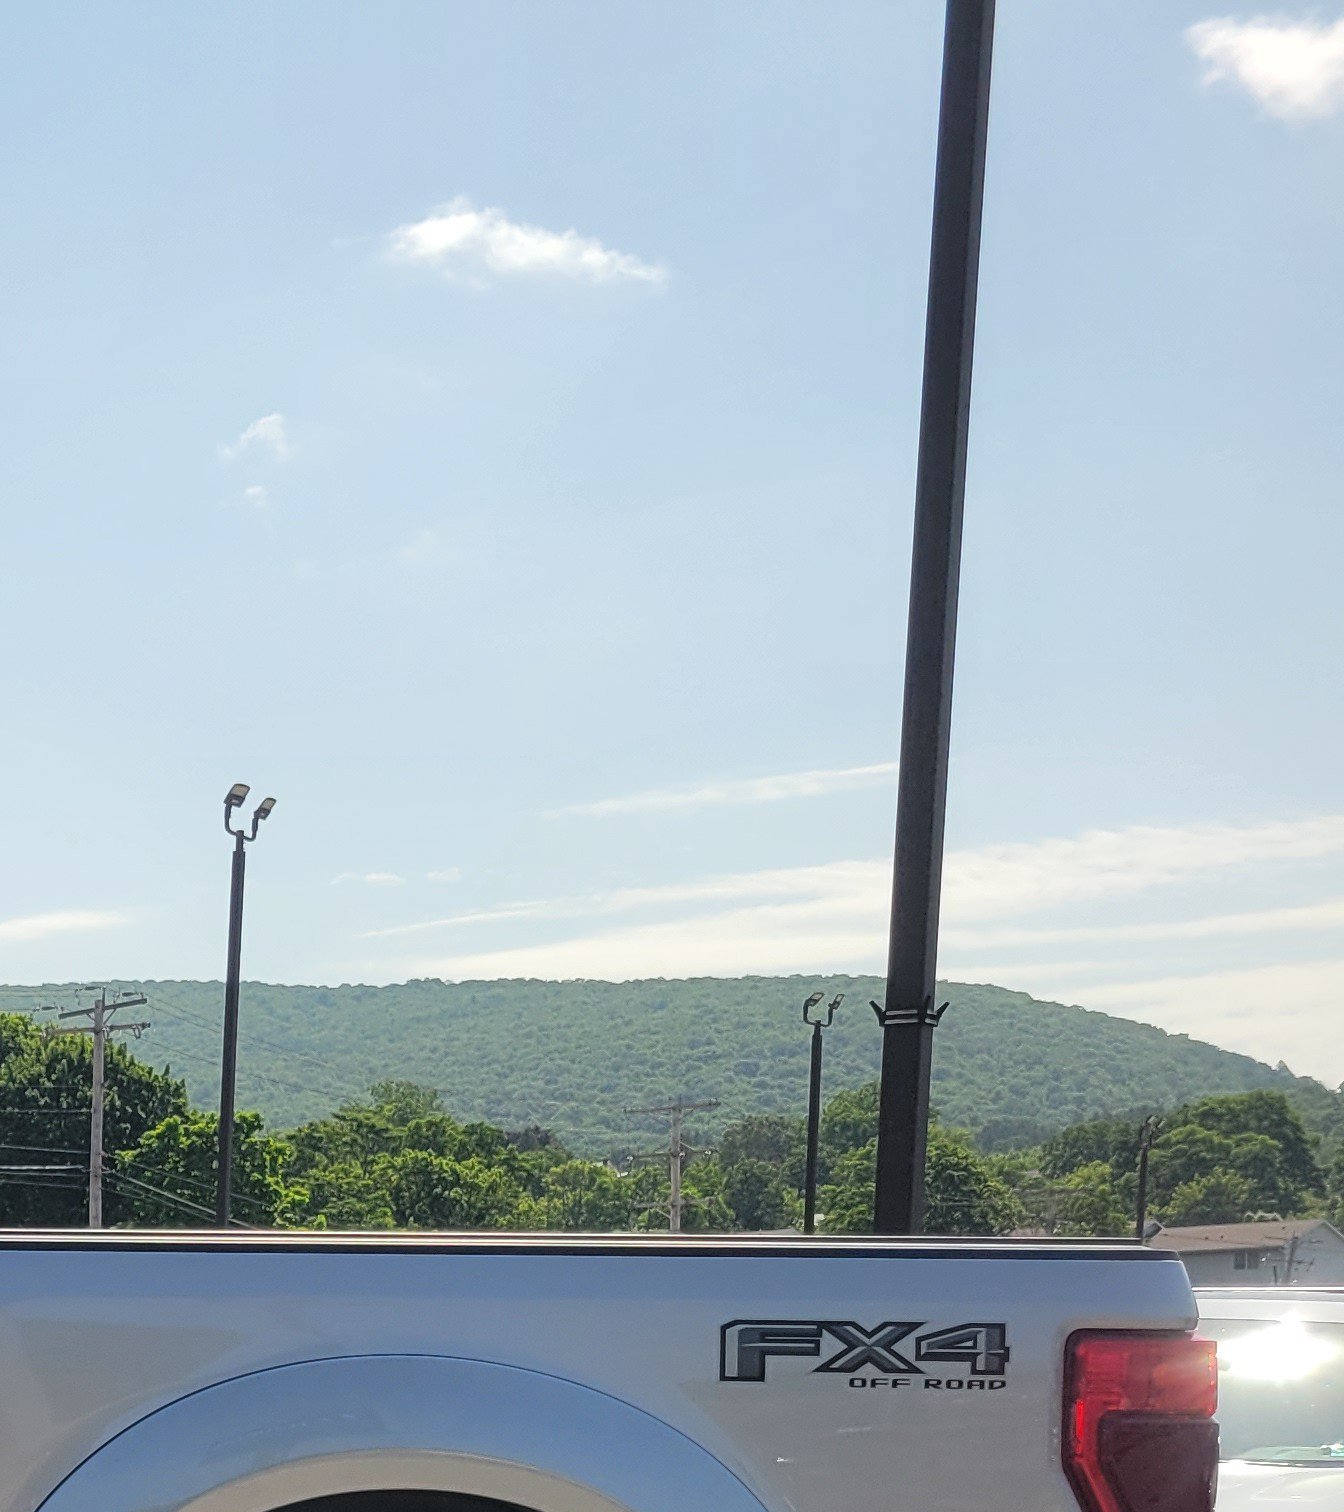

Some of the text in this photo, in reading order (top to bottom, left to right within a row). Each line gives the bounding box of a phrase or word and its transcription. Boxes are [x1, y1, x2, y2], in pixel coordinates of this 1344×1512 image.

[719, 1319, 1009, 1382] FX4
[848, 1377, 1007, 1391] OFF ROAD
